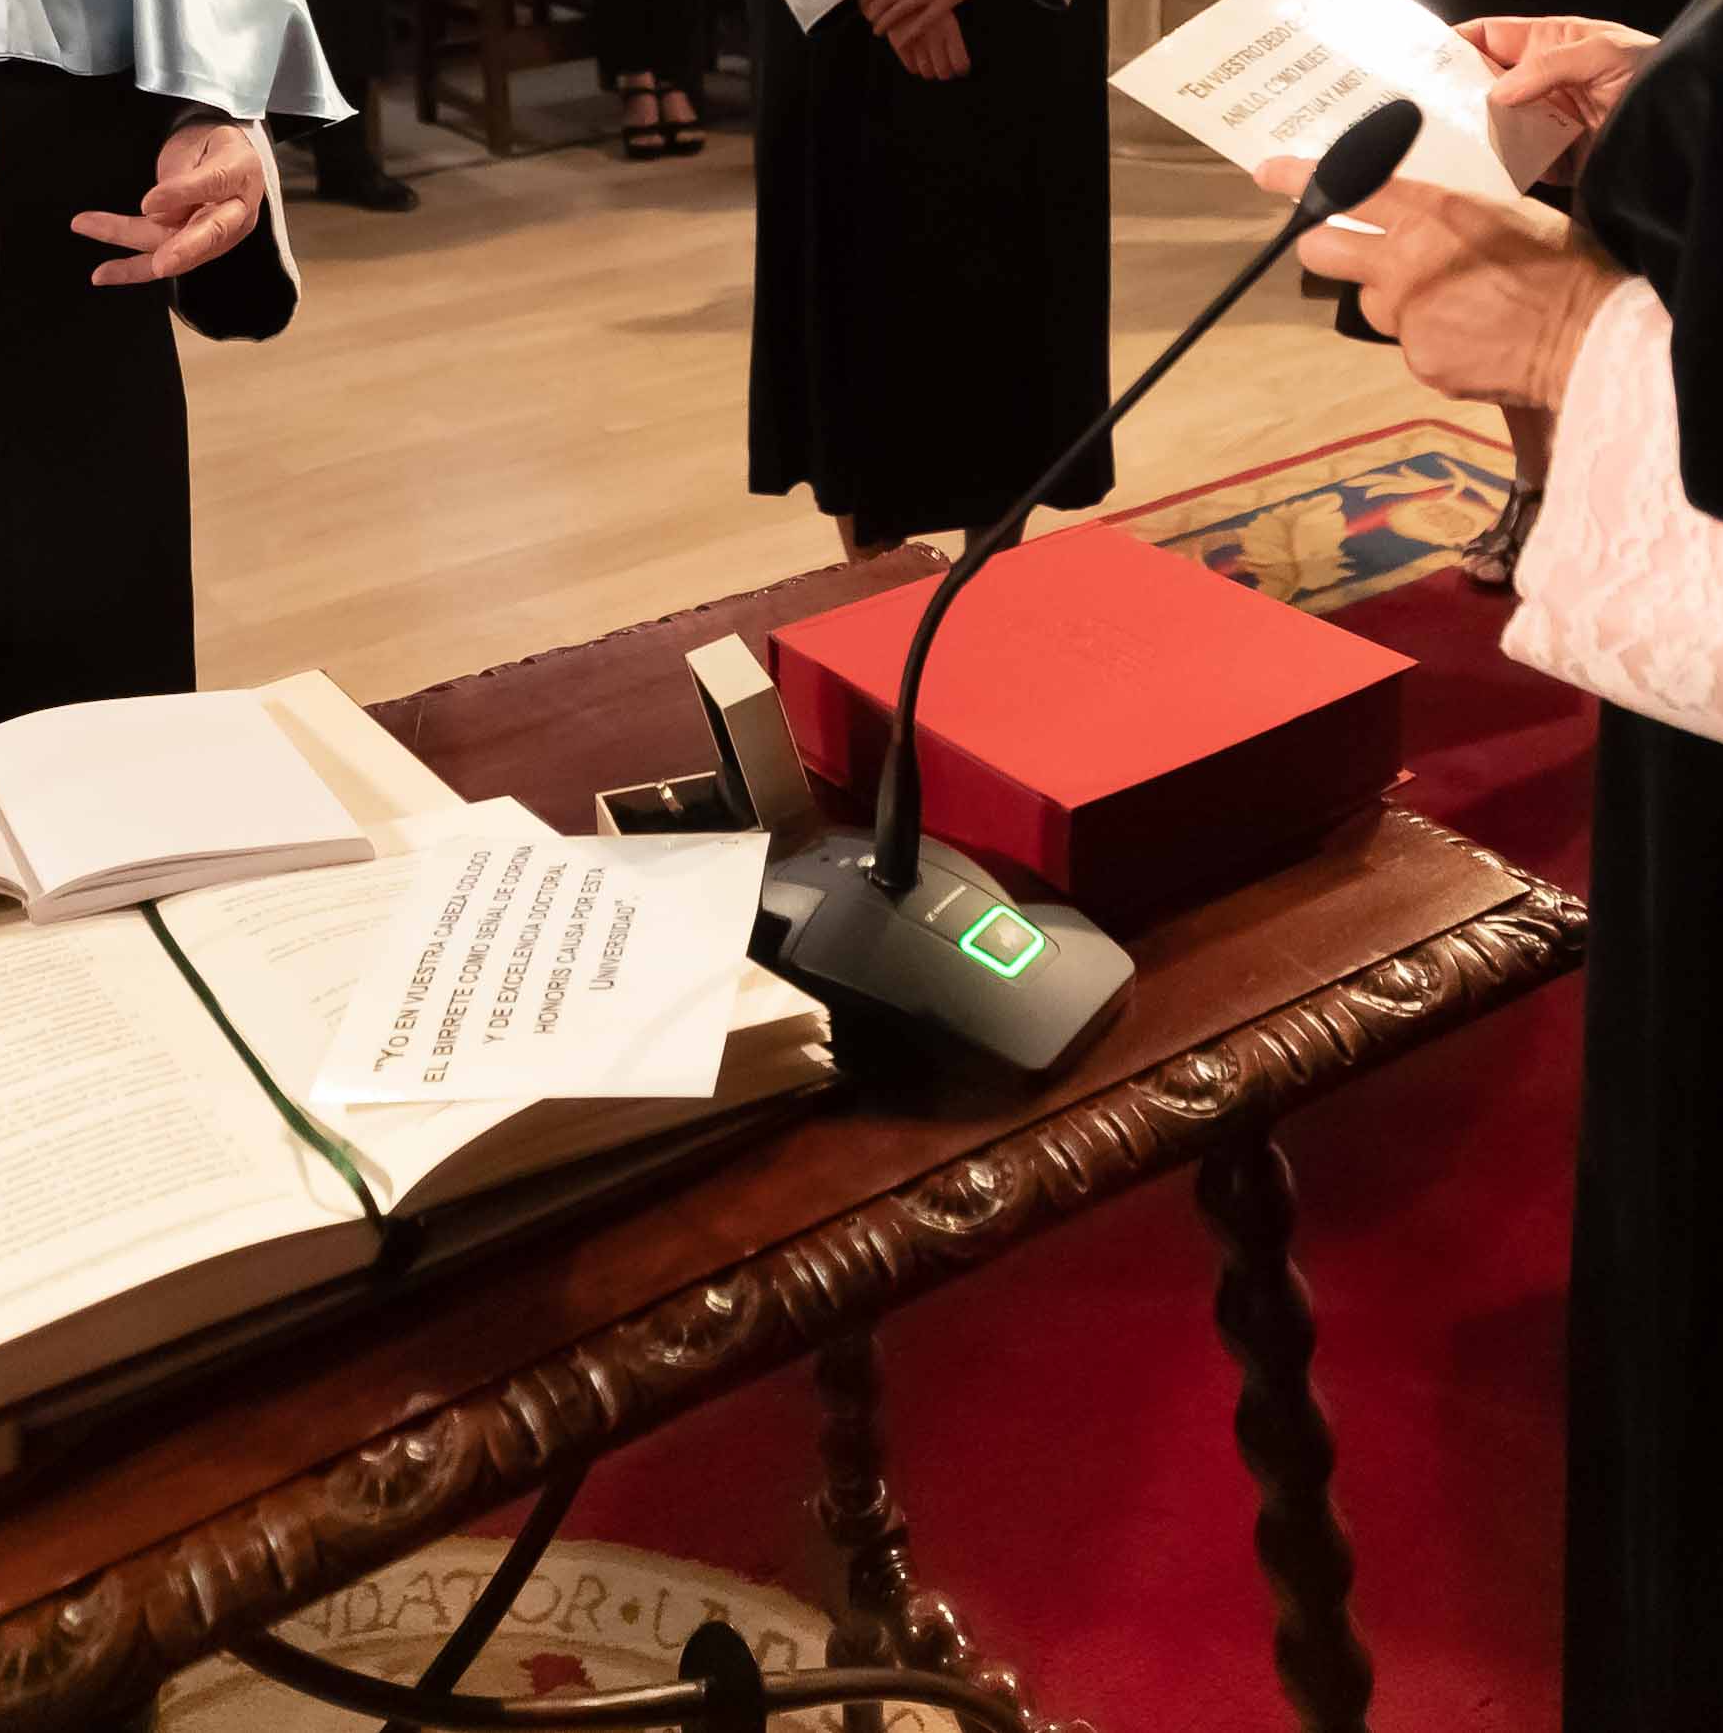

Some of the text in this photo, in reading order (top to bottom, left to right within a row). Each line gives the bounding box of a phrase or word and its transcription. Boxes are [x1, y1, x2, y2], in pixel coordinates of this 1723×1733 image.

[1292, 43, 1333, 74] NUEST
[433, 893, 469, 937] CABEZA
[492, 887, 516, 902] DE
[475, 903, 509, 941] SEÑAL
[458, 943, 491, 985] COMO
[482, 861, 568, 1045] Y DE EXCELENCIA DOCTORAL
[533, 865, 606, 1034] HONORIS CAUSA POR ESTA
[402, 941, 446, 1004] VUESTRA
[394, 1008, 420, 1030] EN
[432, 987, 475, 1056] BIRRETE
[423, 1060, 449, 1083] EL
